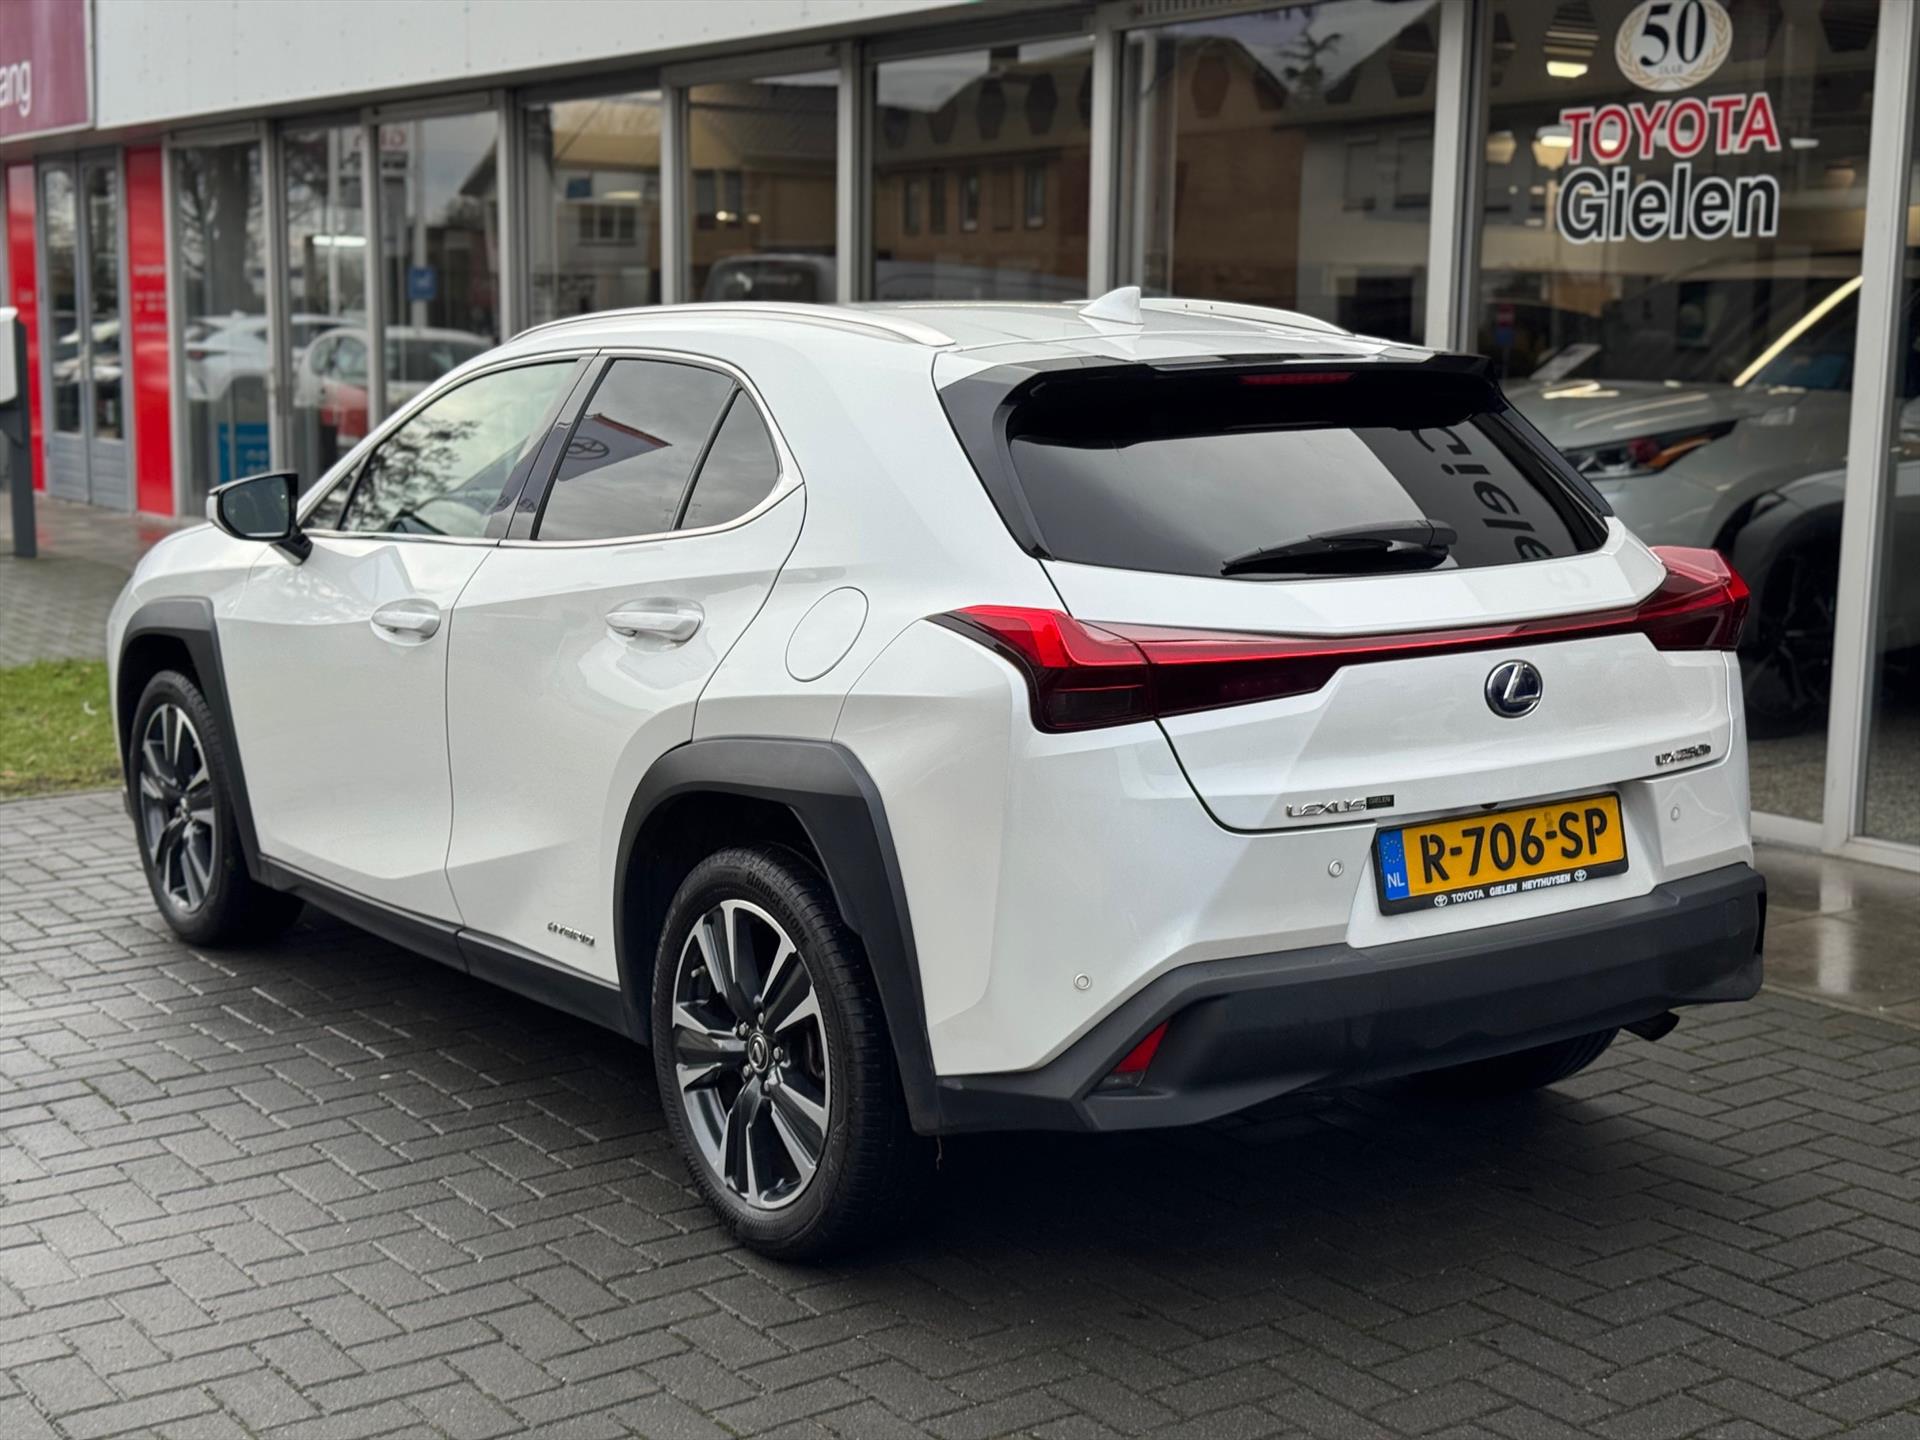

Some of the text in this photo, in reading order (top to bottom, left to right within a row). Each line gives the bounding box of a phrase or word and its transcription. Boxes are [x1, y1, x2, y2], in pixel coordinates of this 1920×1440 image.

[1640, 0, 1706, 66] 50
[1561, 93, 1781, 164] TOYOTA
[1557, 163, 1779, 244] Gielen
[1286, 799, 1366, 818] LEXUS
[1420, 807, 1607, 884] R-706-SP
[1387, 872, 1405, 889] NL
[1451, 873, 1571, 904] TOYOTA GIELEN HEYTHUYSEN
[547, 922, 595, 947] HYBRID
